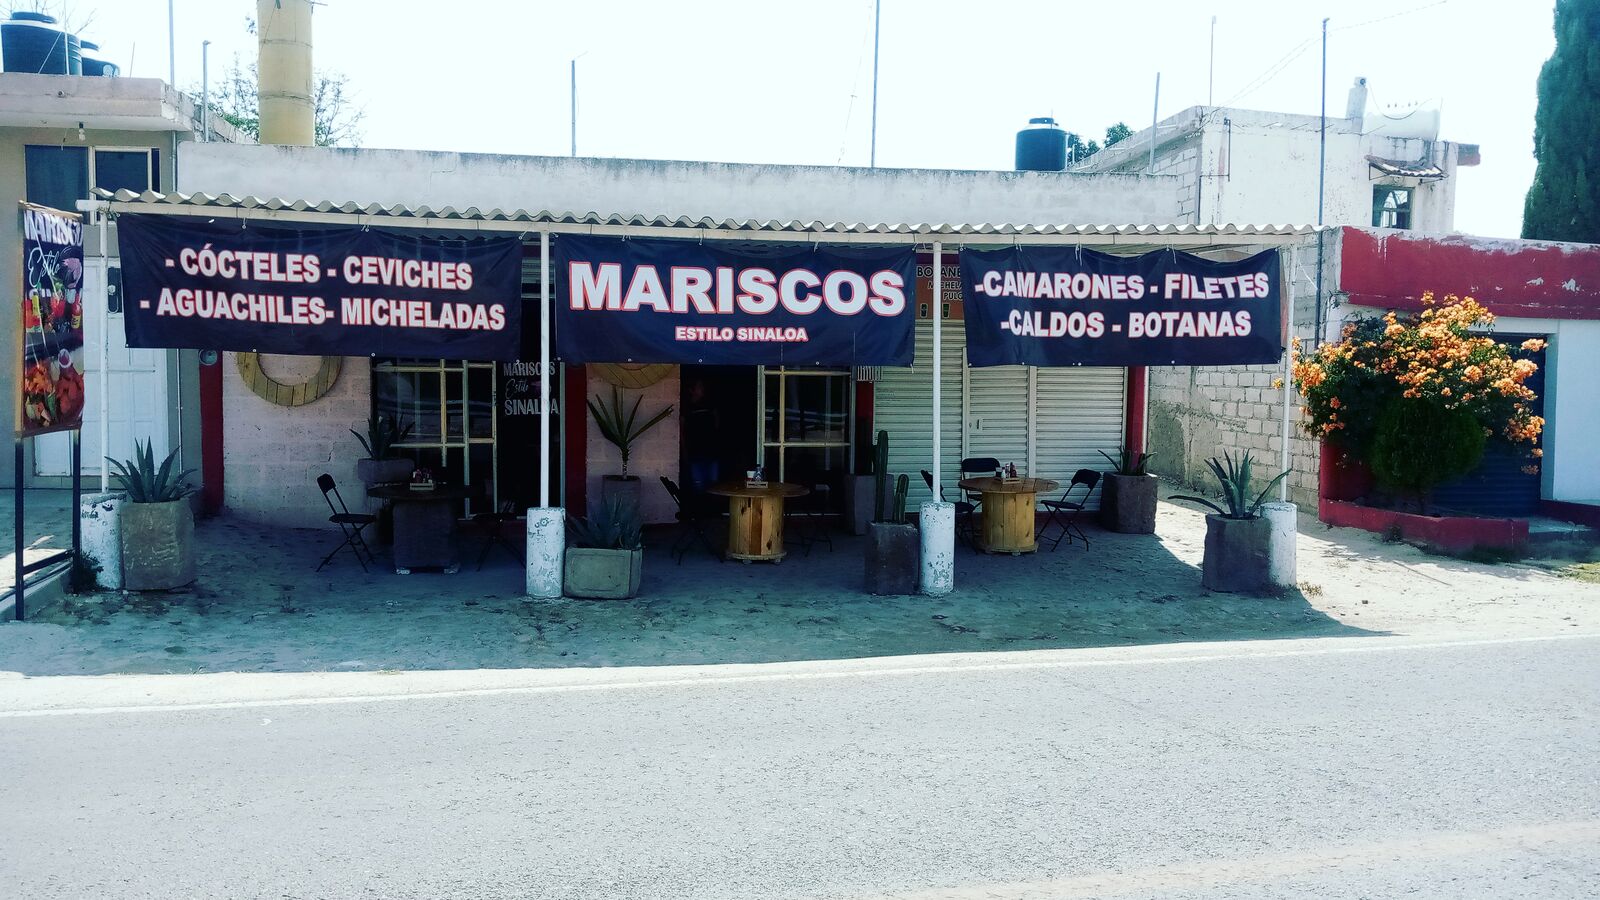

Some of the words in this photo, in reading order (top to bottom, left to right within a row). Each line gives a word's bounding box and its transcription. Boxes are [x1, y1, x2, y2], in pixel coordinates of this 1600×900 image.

[179, 242, 321, 284] CÓCTELES
[342, 255, 473, 291] CEVICHES
[568, 260, 906, 317] MARISCOS
[1164, 271, 1270, 300] FILETES
[340, 297, 505, 331] MICHELADAS
[1128, 310, 1252, 338] BOTANAS
[674, 325, 735, 342] ESTILO
[736, 326, 809, 343] SINALOA
[503, 362, 555, 376] MARISCS
[504, 398, 559, 415] SINALA
